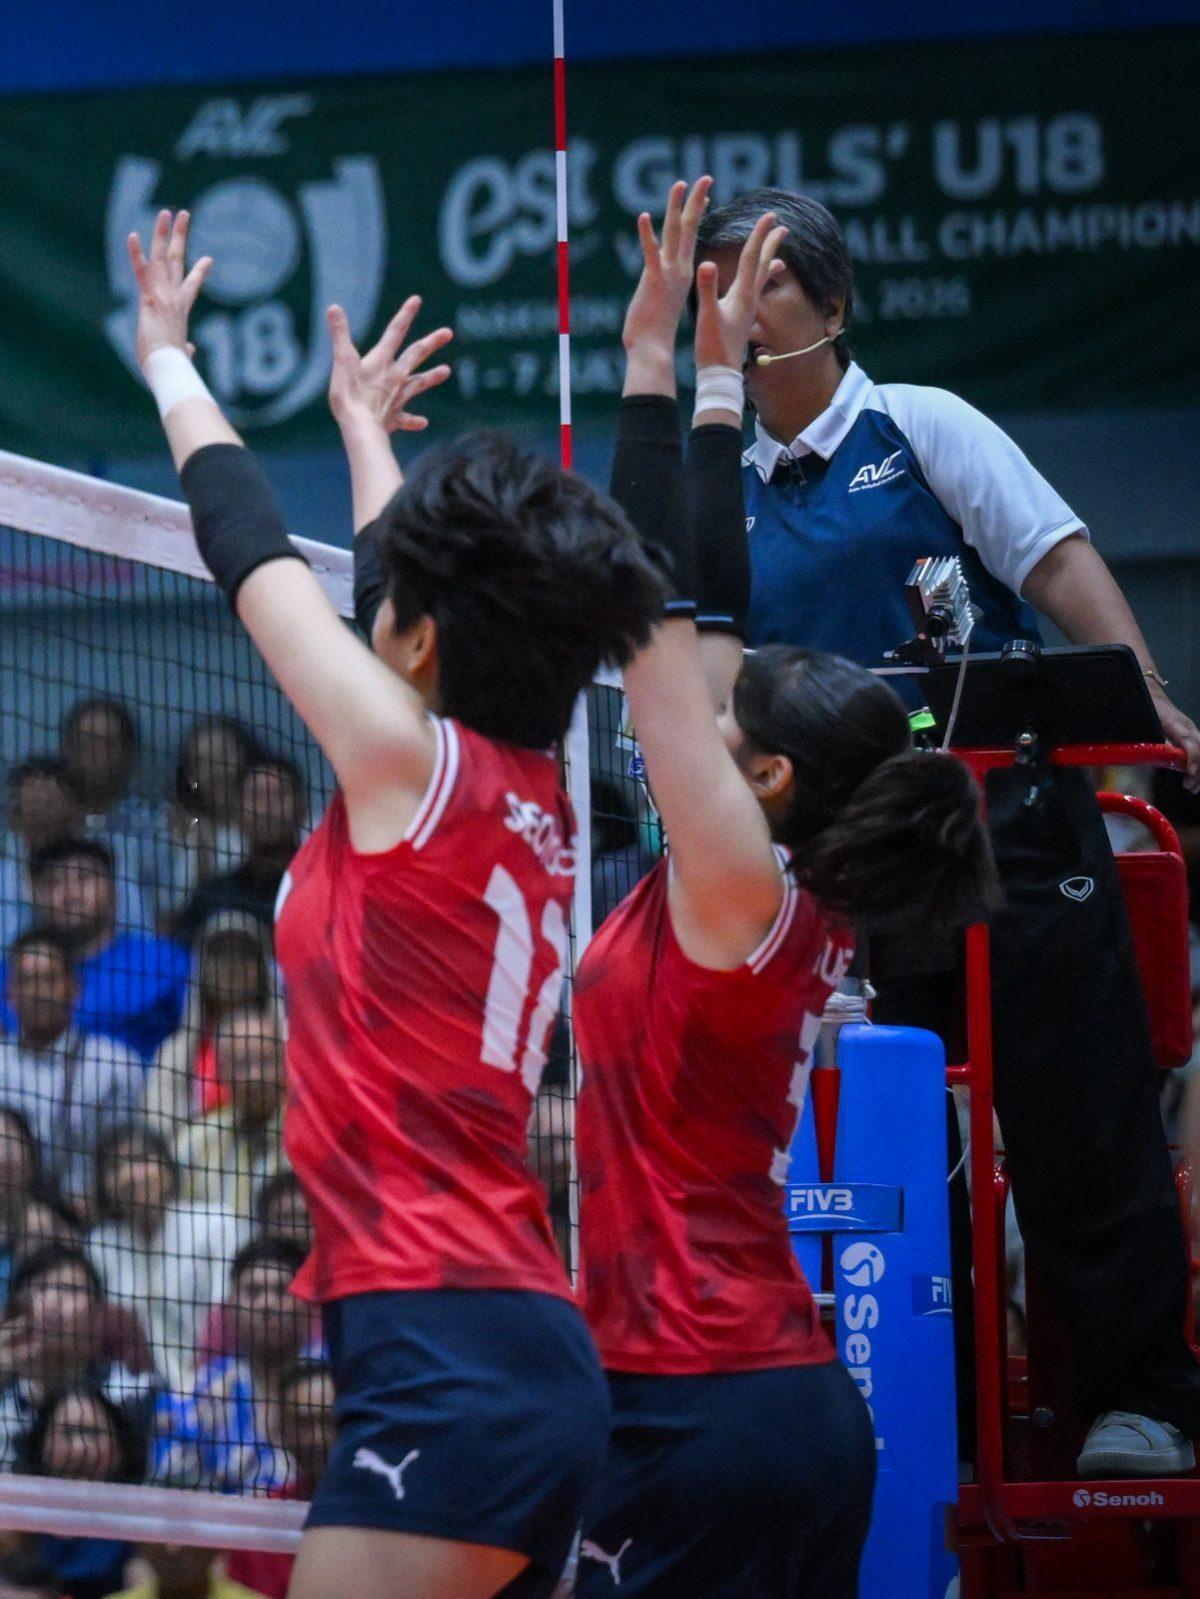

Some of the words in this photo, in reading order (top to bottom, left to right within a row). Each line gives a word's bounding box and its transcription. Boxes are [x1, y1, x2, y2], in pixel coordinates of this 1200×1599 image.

[442, 136, 597, 287] est
[932, 111, 1104, 200] U18
[196, 299, 299, 398] 18
[848, 449, 903, 488] AVC
[790, 1188, 854, 1212] FIVB
[843, 1293, 886, 1451] Sen
[1092, 1490, 1165, 1507] Senoh
